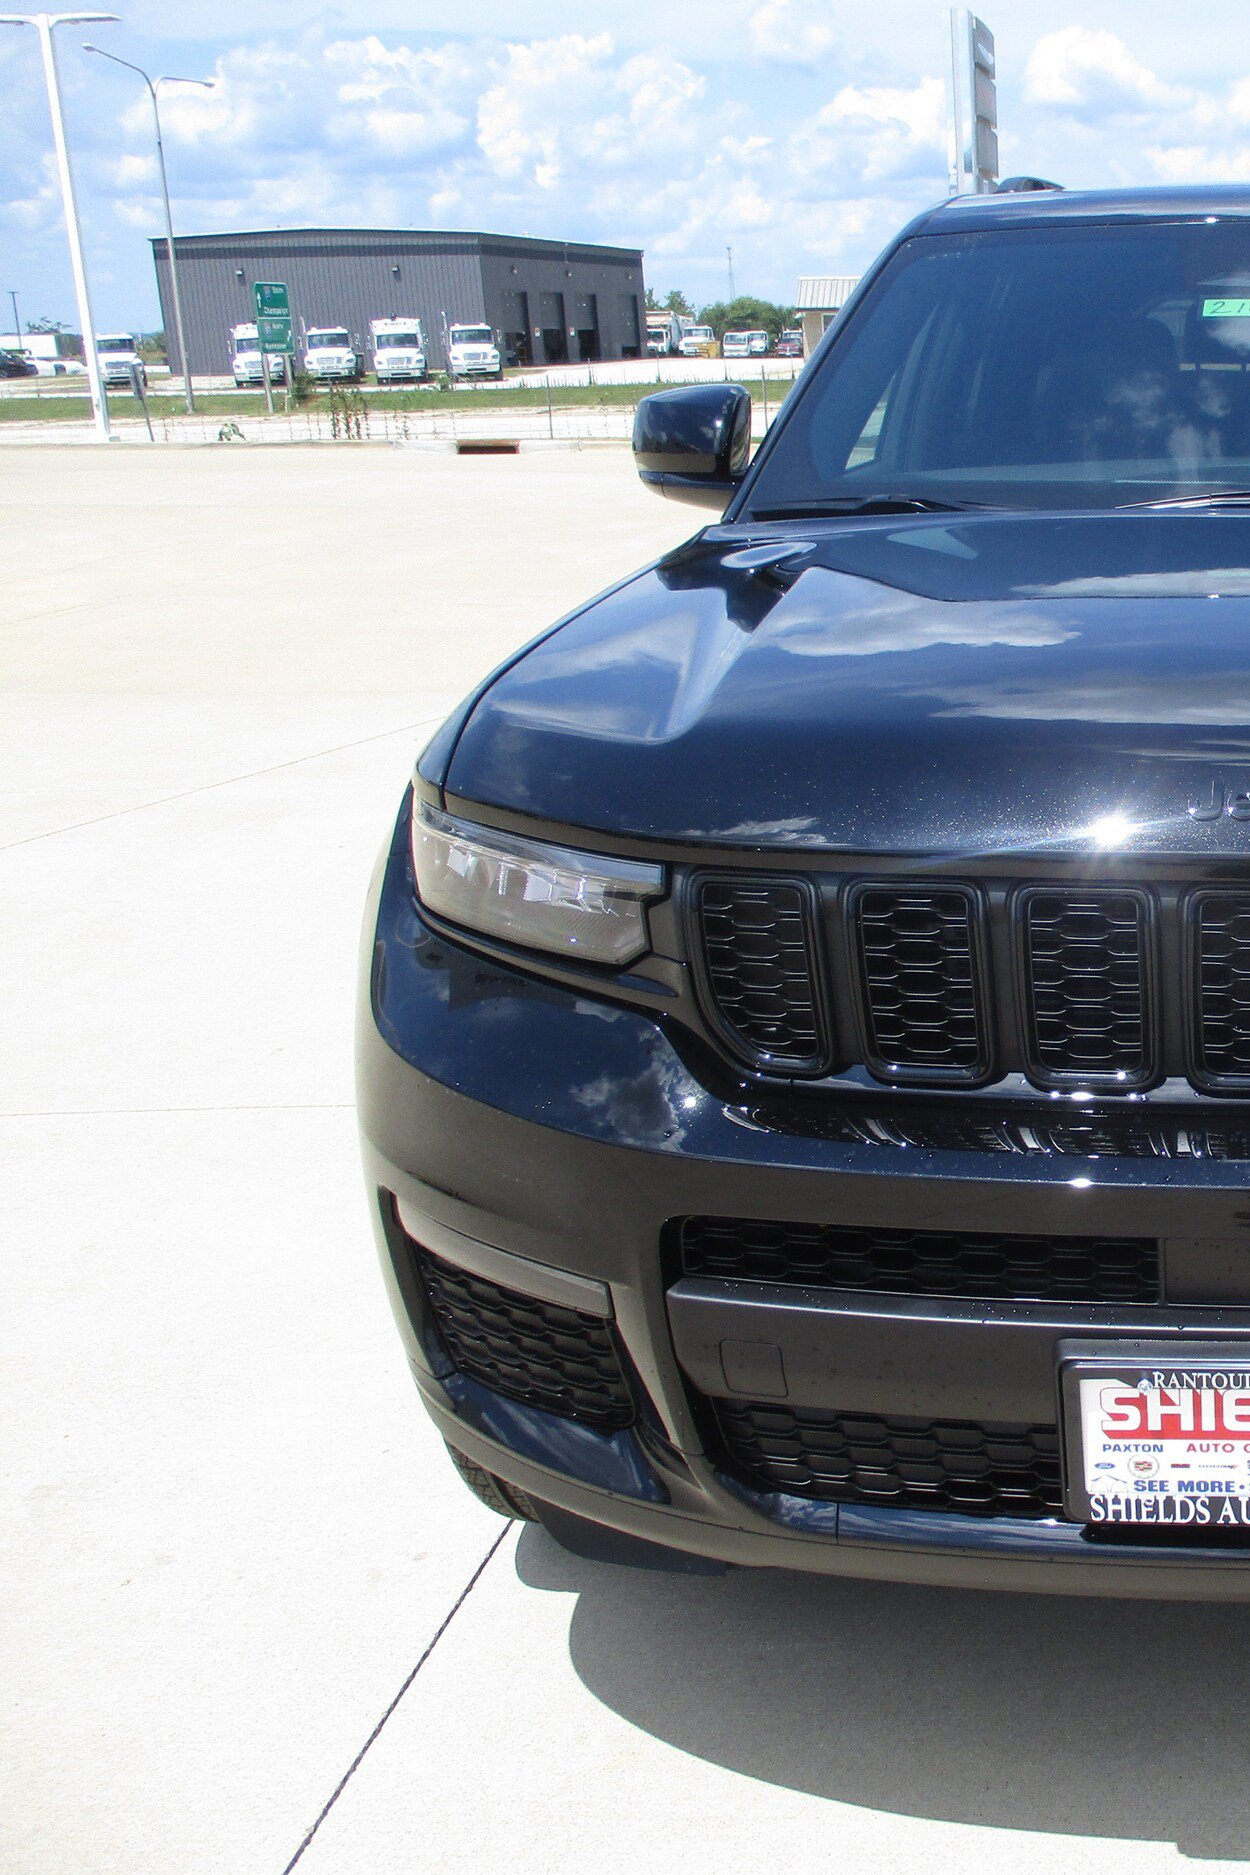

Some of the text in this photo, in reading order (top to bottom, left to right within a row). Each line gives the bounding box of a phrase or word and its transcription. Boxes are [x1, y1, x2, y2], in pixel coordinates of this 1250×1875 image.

[1102, 1443, 1164, 1453] PAXTON
[1186, 1443, 1235, 1453] AUTO
[1133, 1480, 1170, 1492] SEE
[1177, 1480, 1236, 1493] MORE
[1089, 1492, 1211, 1524] SHIELDS
